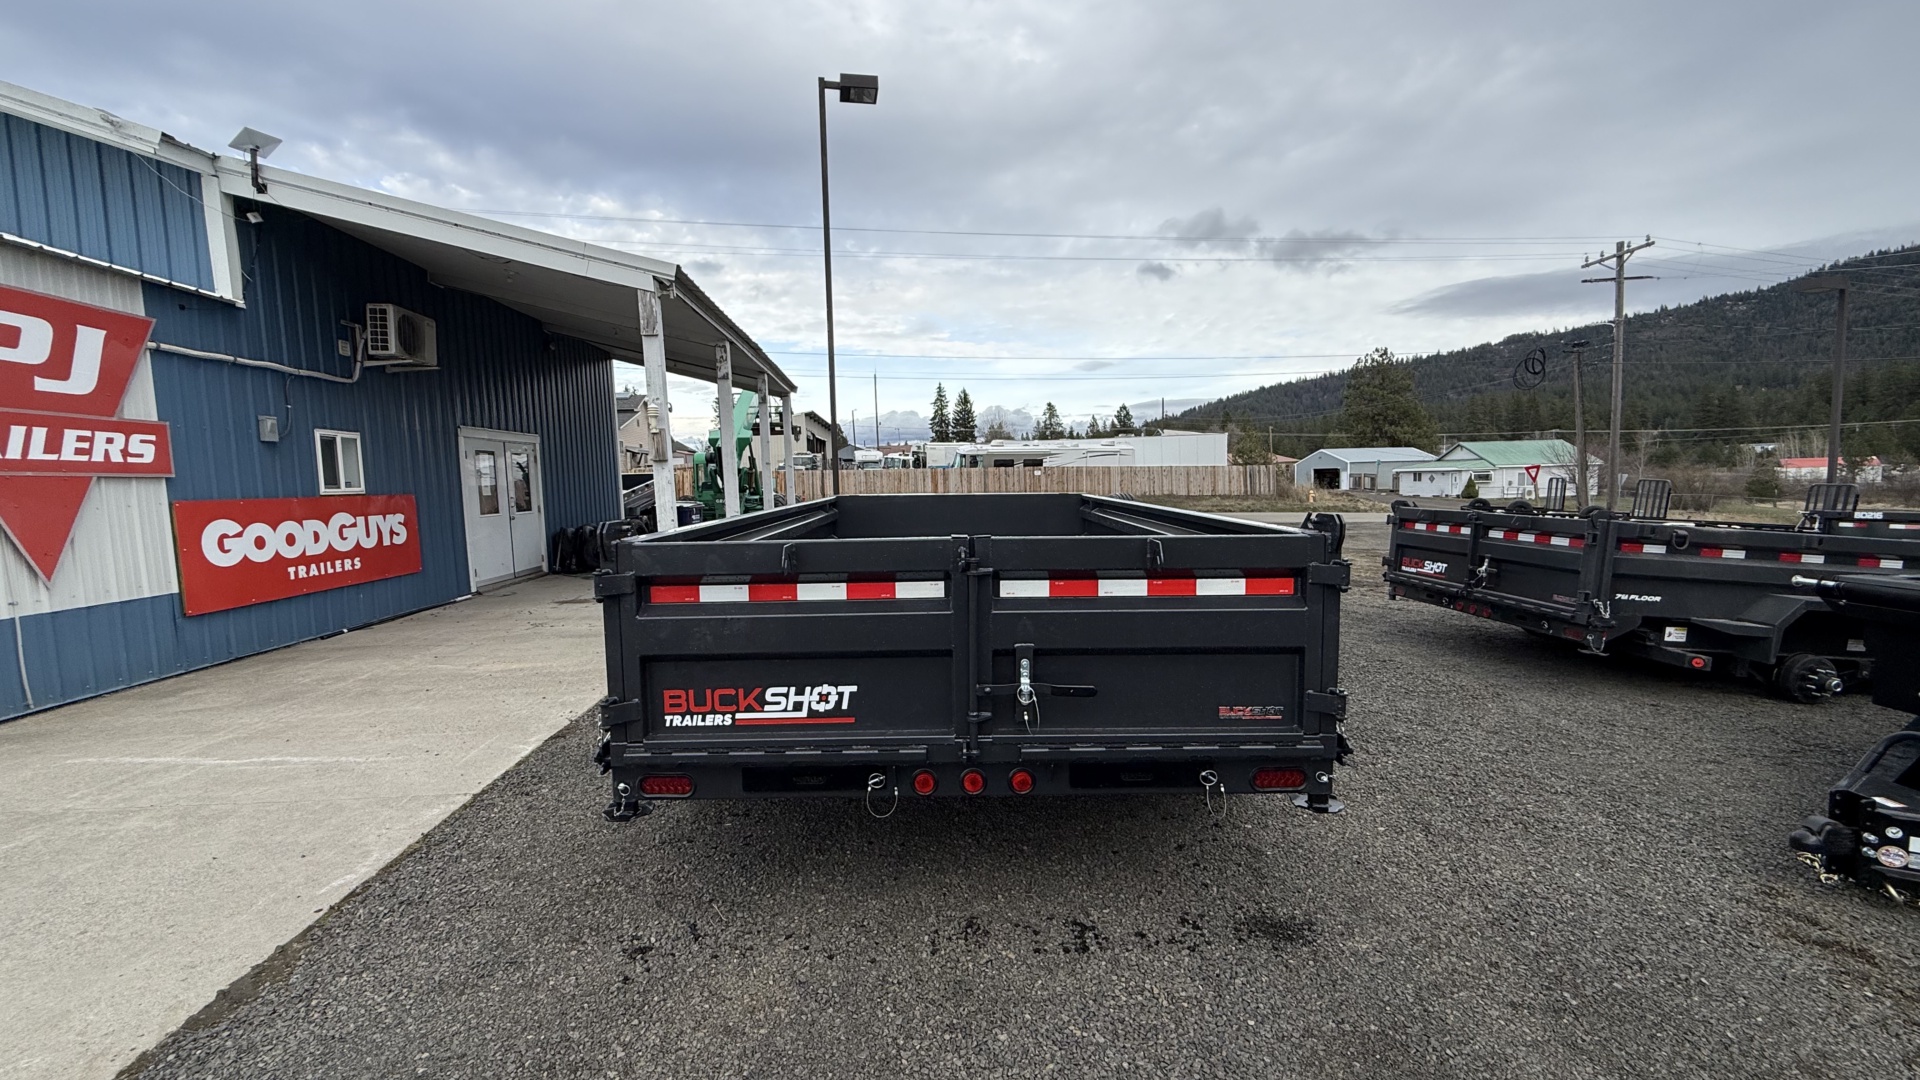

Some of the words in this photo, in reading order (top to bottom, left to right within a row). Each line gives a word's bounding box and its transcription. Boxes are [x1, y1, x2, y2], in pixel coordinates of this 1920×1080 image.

[0, 425, 157, 463] ILERS
[201, 512, 408, 568] GOODGUYS
[288, 557, 361, 580] TRAILERS
[1629, 594, 1662, 603] FLOOR
[663, 684, 858, 712] BUCKSHOT
[664, 714, 733, 727] TRAILERS
